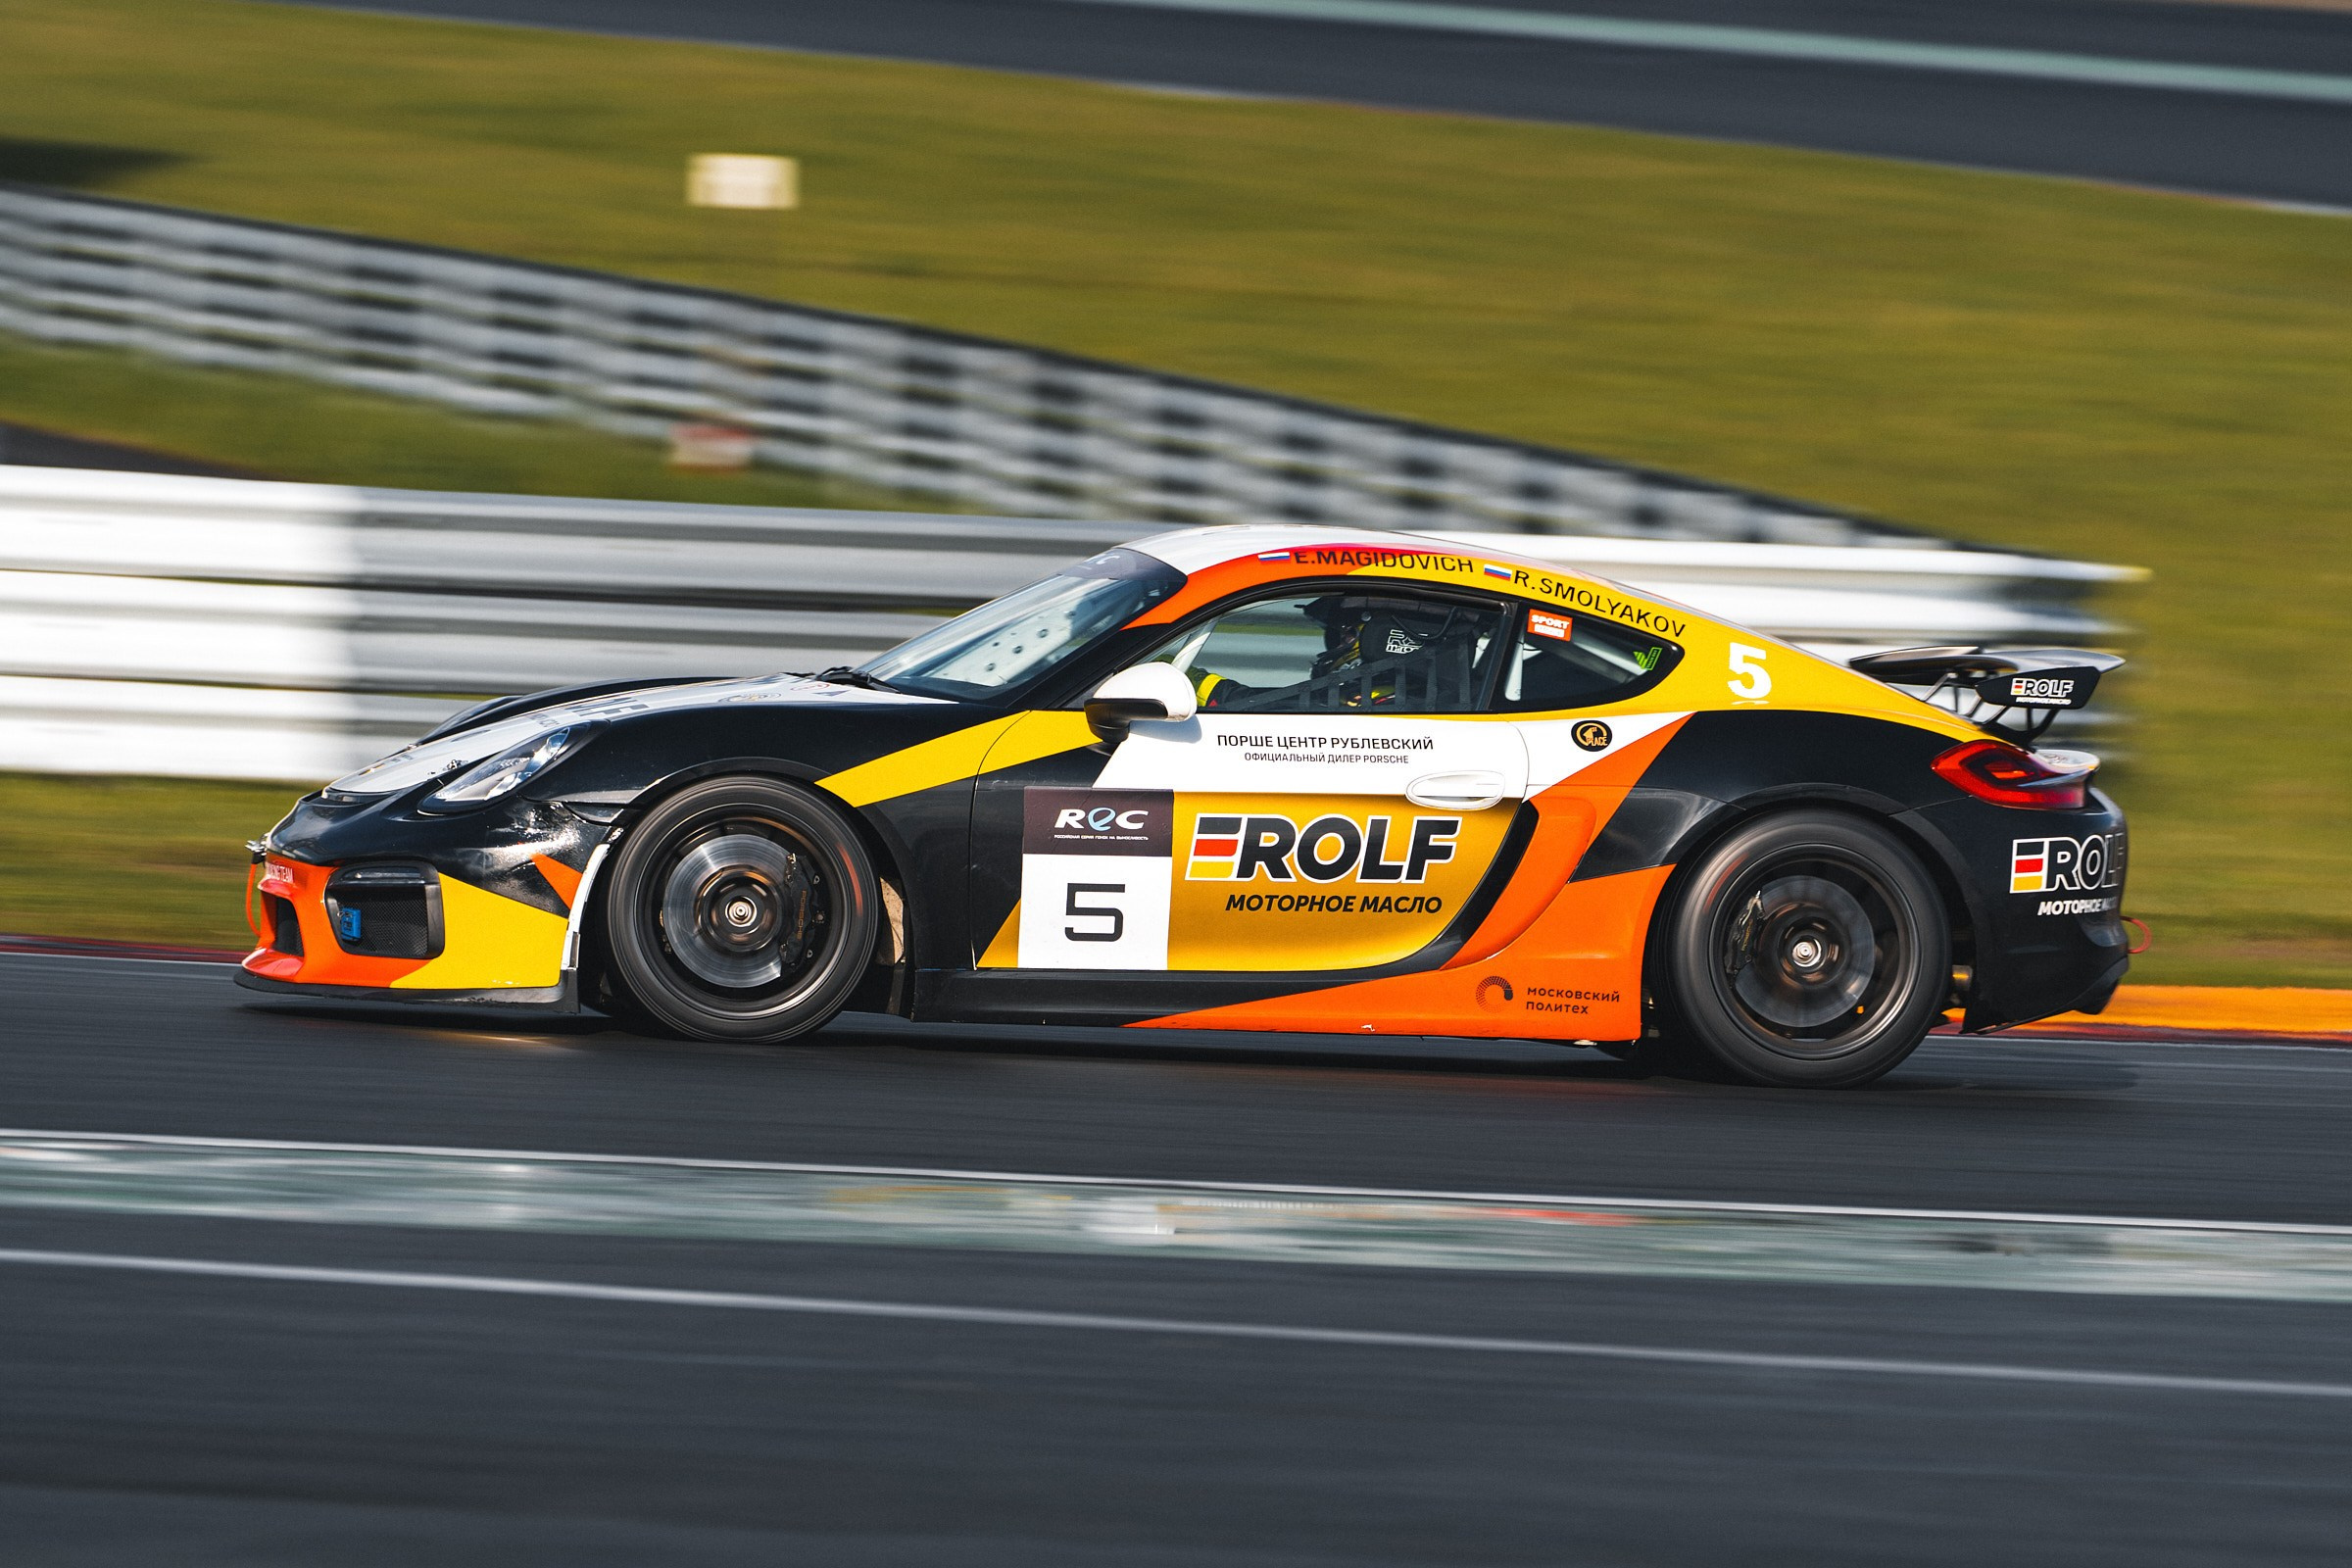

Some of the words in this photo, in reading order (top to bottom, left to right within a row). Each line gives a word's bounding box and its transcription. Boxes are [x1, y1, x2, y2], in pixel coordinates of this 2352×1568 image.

[1294, 551, 1474, 573] E.MAGIDOVICH
[1513, 569, 1687, 638] R.SMOLYAKOV
[1531, 613, 1570, 630] SPORT
[1727, 642, 1772, 699] 5
[2024, 679, 2075, 698] ROLF
[1217, 734, 1274, 748] ПОРШЕ
[1277, 736, 1328, 751] ЦЕНТР
[1331, 736, 1435, 751] РУБЛЕВСКИЙ
[1244, 752, 1326, 763] ОФИЦИАЛЬНЫЙ
[1327, 754, 1362, 764] ДИЛЕР
[1363, 755, 1409, 764] PORSCHE
[1235, 812, 1463, 884] ROLF
[1064, 882, 1126, 943] 5
[1225, 894, 1357, 913] МОТОРНОЕ
[1359, 895, 1443, 914] МАСЛО
